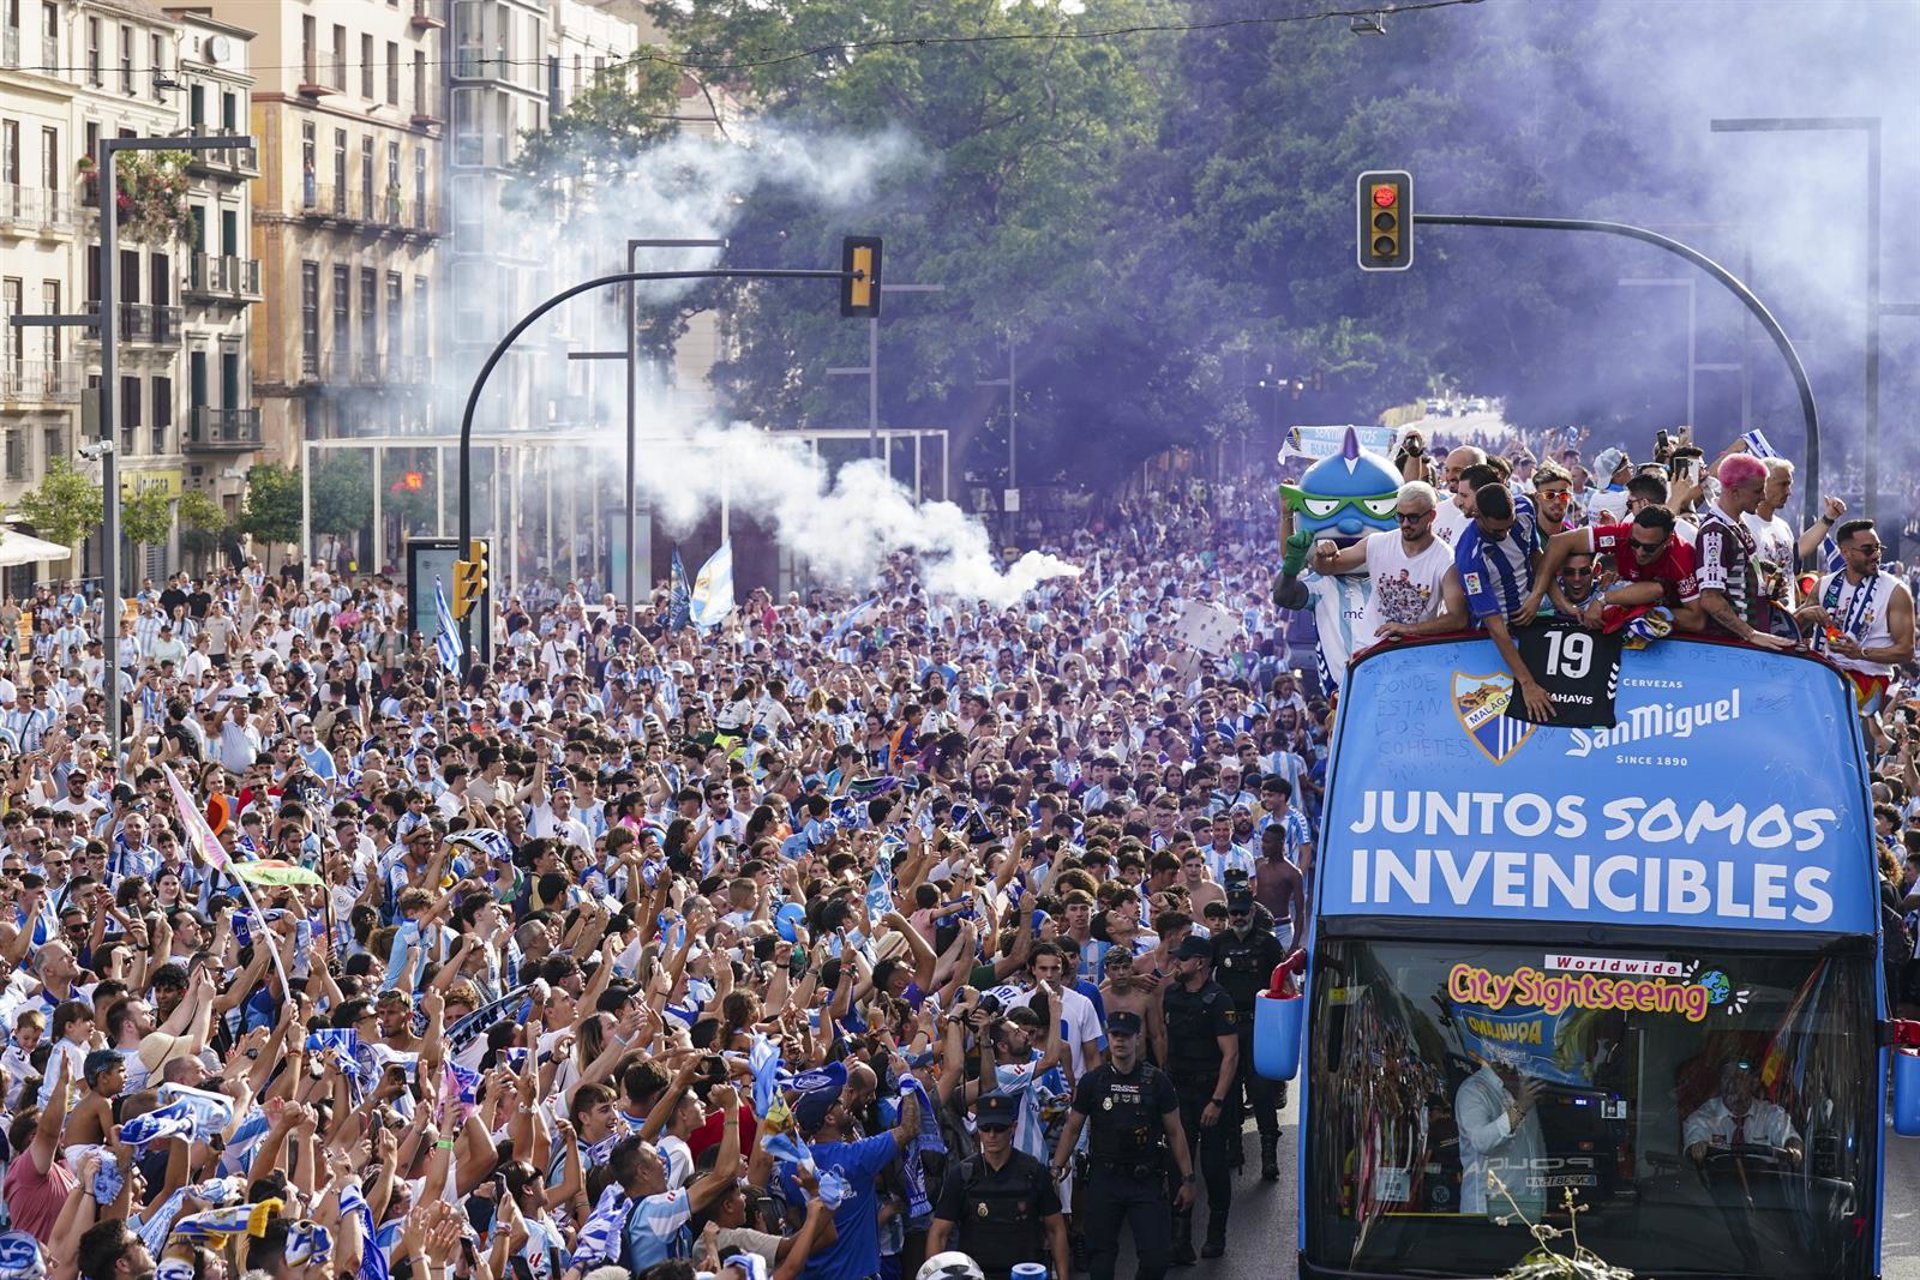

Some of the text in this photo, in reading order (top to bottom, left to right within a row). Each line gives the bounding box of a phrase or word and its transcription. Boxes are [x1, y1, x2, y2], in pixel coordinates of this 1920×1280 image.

[1544, 631, 1594, 679] 19
[1374, 673, 1438, 696] DONDE
[1623, 678, 1684, 689] CERVEZAS
[1377, 697, 1441, 717] ESTAN
[1547, 692, 1594, 705] AHAVIS
[1375, 720, 1426, 737] LOS
[1378, 738, 1471, 758] COHETES
[1616, 754, 1688, 767] SINCE 1890
[1350, 789, 1837, 852] JUNTOS SOMOS
[1350, 848, 1835, 924] INVENCIBLES
[1556, 957, 1678, 976] Worldwide
